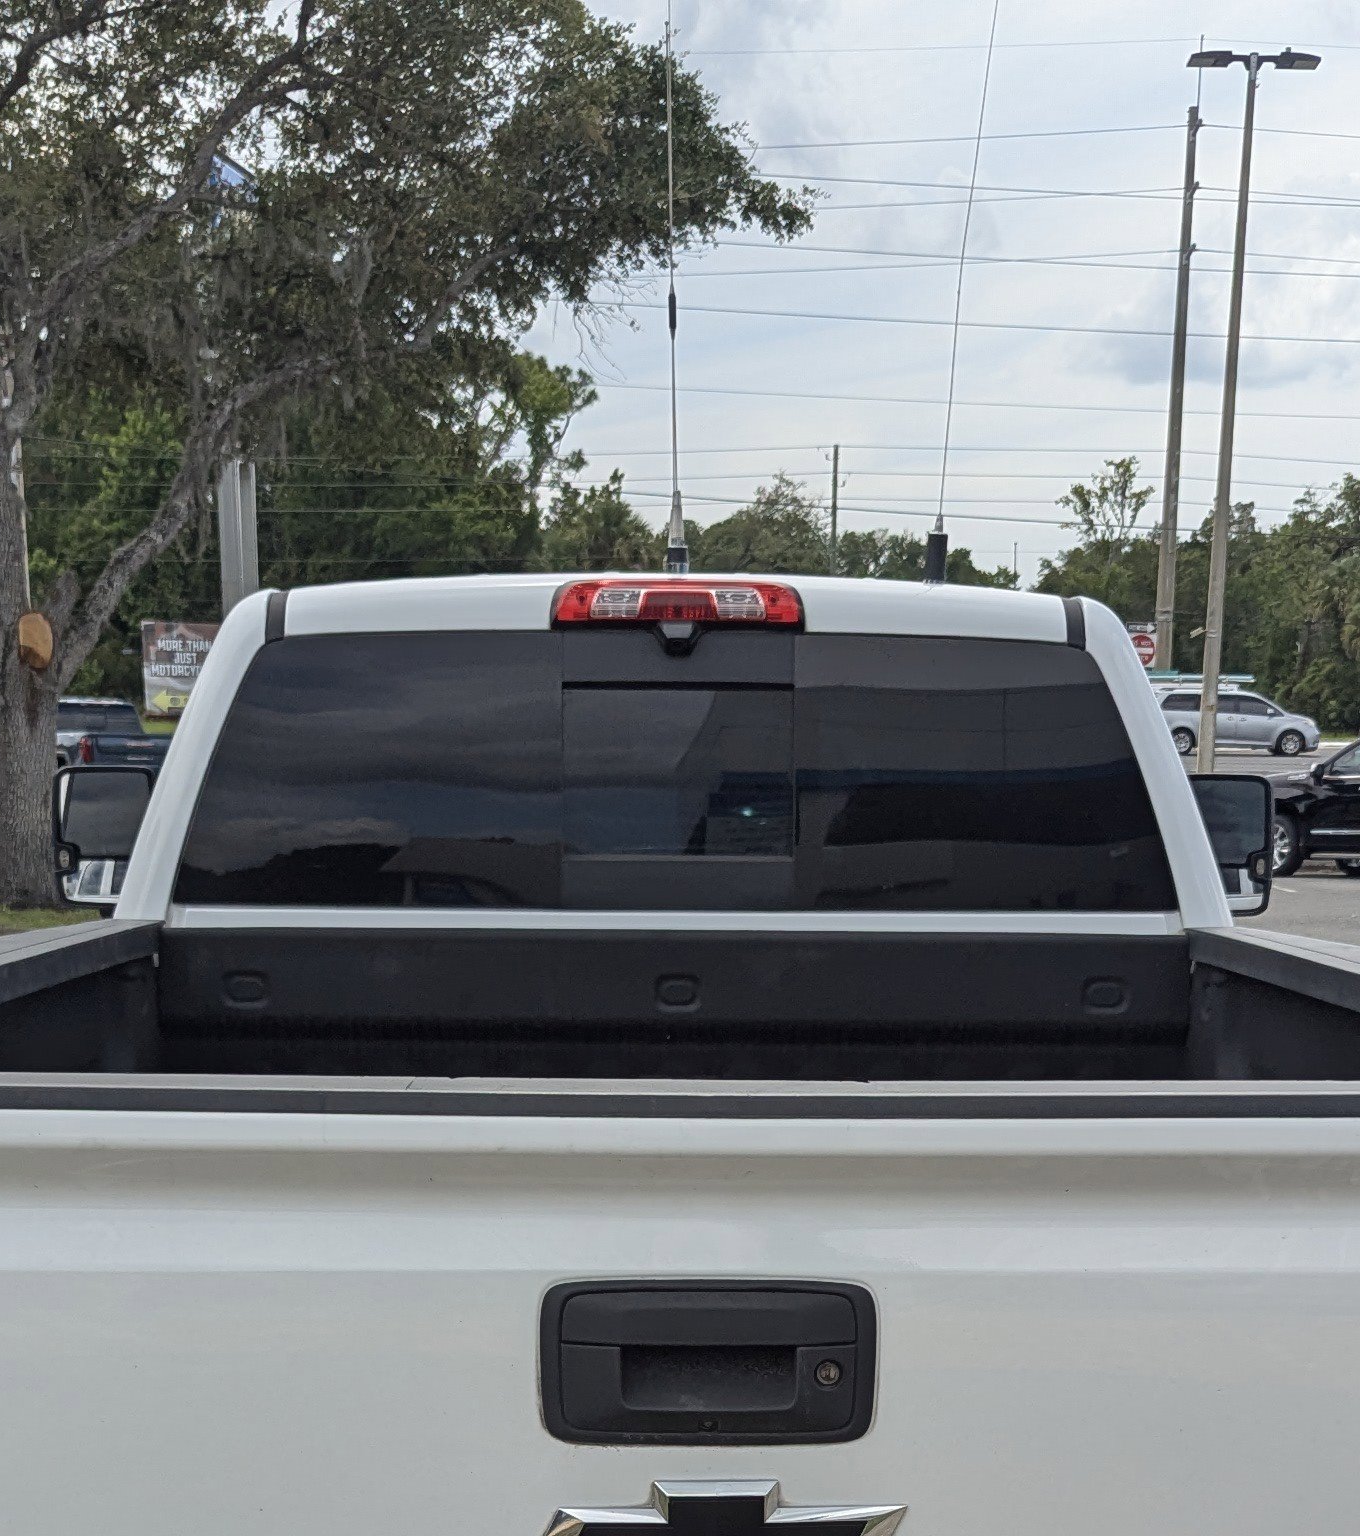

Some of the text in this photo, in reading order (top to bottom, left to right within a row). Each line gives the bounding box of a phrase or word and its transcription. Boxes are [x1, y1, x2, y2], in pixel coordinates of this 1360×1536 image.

[157, 640, 184, 652] MORE
[174, 653, 197, 664] JUST
[151, 665, 202, 677] MOTORCY
